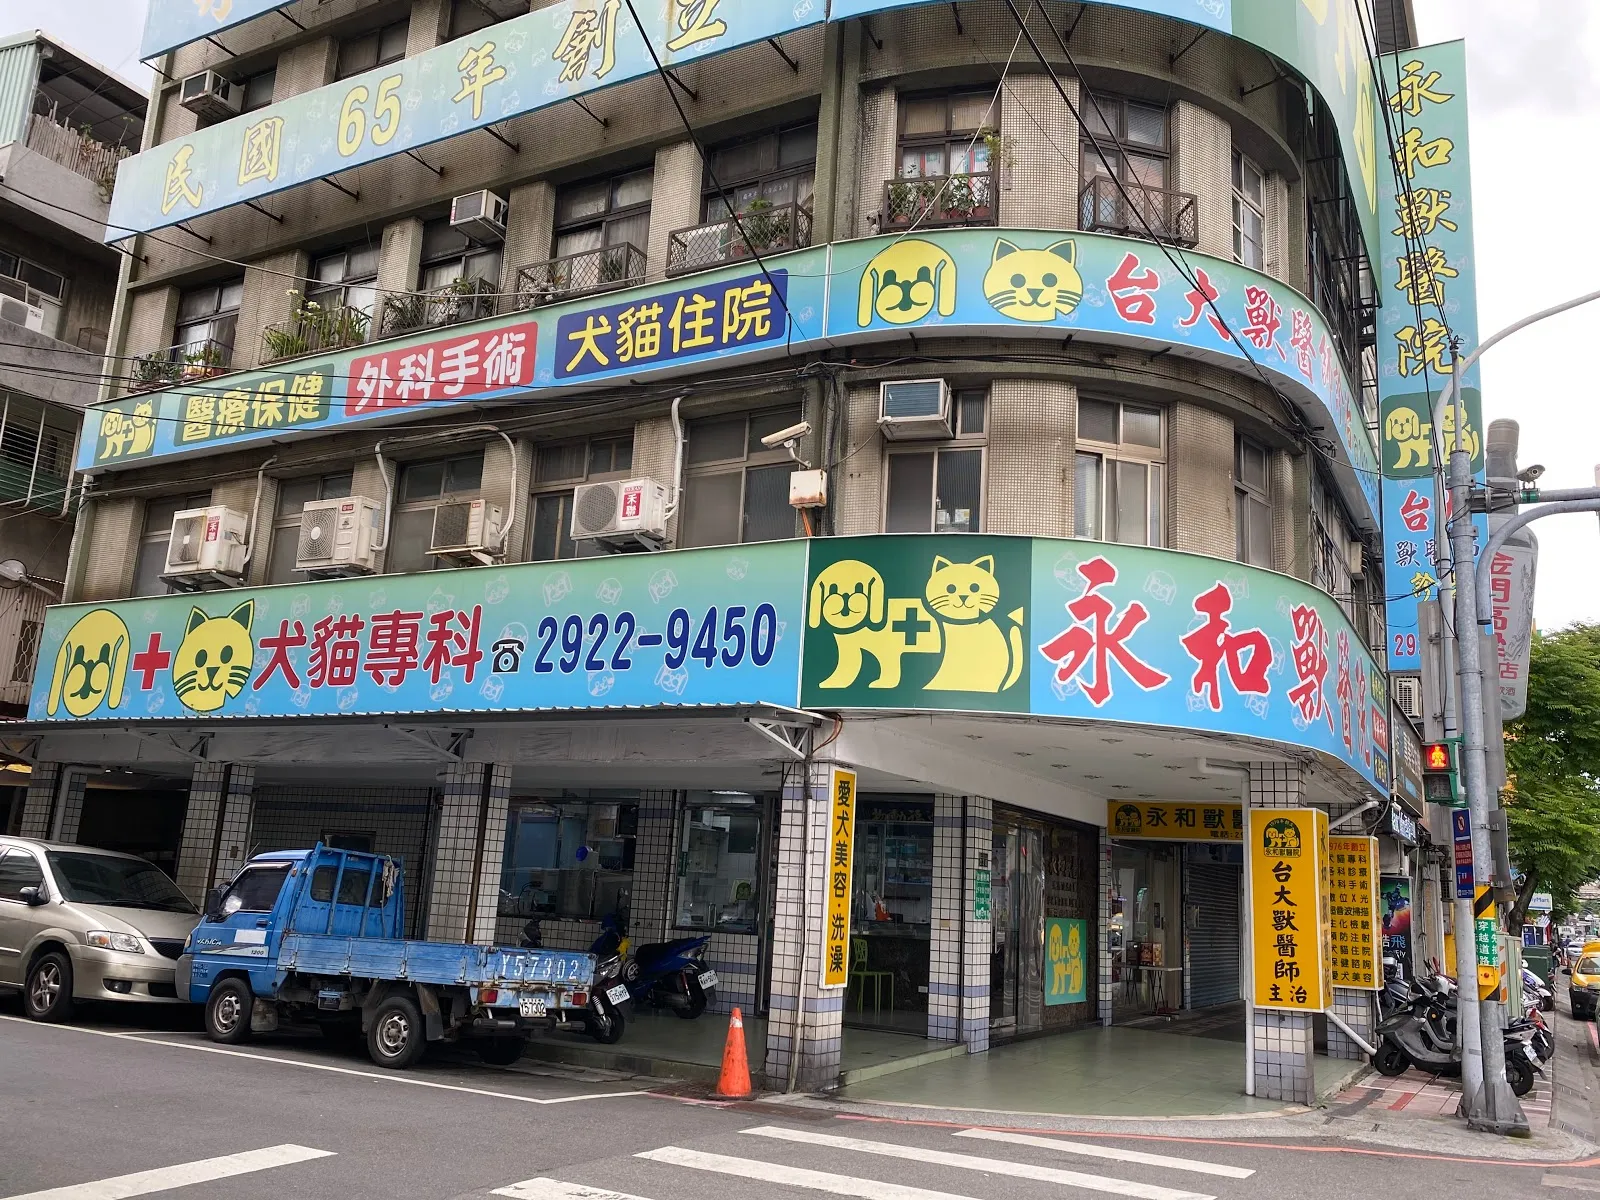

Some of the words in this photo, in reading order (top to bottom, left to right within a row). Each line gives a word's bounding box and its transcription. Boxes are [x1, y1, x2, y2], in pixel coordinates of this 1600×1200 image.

[161, 0, 727, 216] 民國65年創立
[1388, 59, 1464, 378] 永和獸醫院
[566, 279, 773, 373] 犬貓住院
[182, 370, 325, 442] 醫療保健
[355, 331, 527, 412] 外科手術
[253, 604, 484, 692] 犬貓專科
[533, 601, 778, 675] 2922-9450
[1037, 554, 1371, 770] 永和獸醫院
[1394, 633, 1421, 657] 29
[1329, 842, 1367, 852] 976年創立
[1271, 860, 1300, 983] 台大獸醫師
[502, 953, 578, 980] Y57302
[1268, 983, 1307, 1004] 主治
